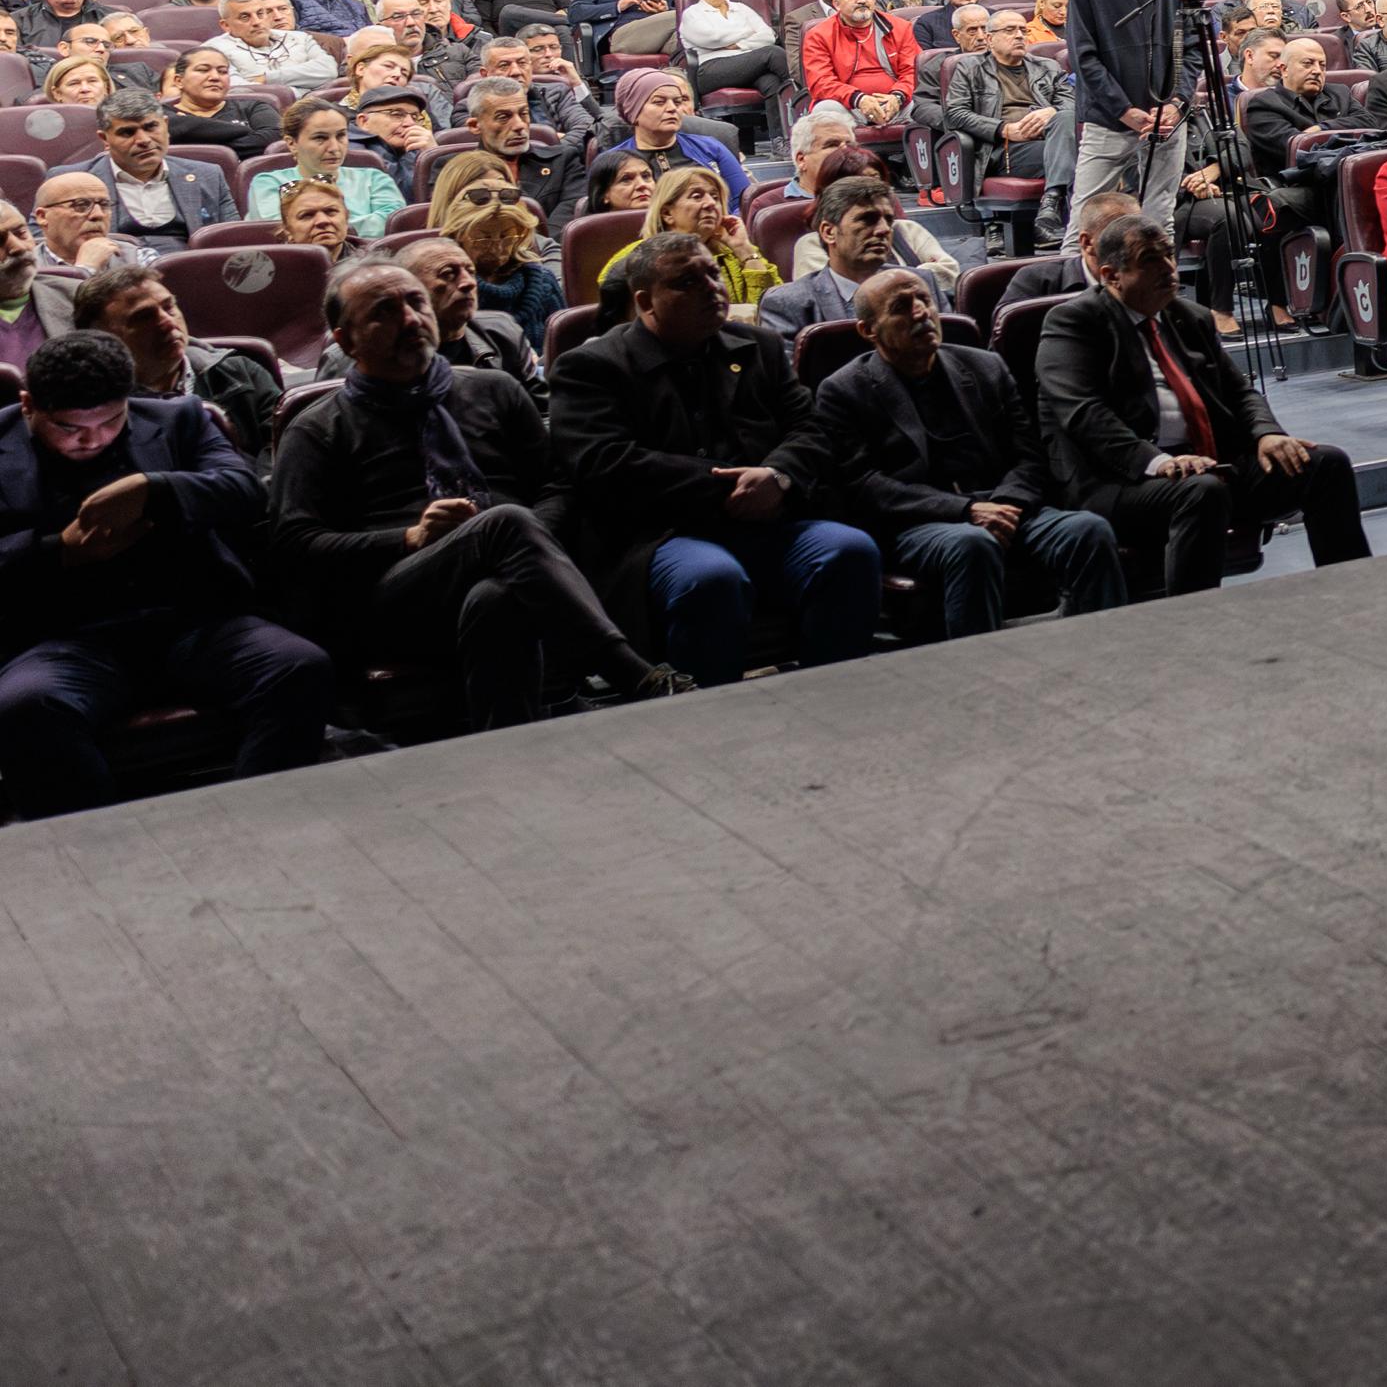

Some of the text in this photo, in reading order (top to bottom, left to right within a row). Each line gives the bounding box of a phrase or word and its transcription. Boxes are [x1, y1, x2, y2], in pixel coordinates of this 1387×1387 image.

[919, 148, 926, 162] H
[951, 162, 957, 176] G
[1300, 264, 1307, 281] D
[1360, 293, 1369, 312] C
